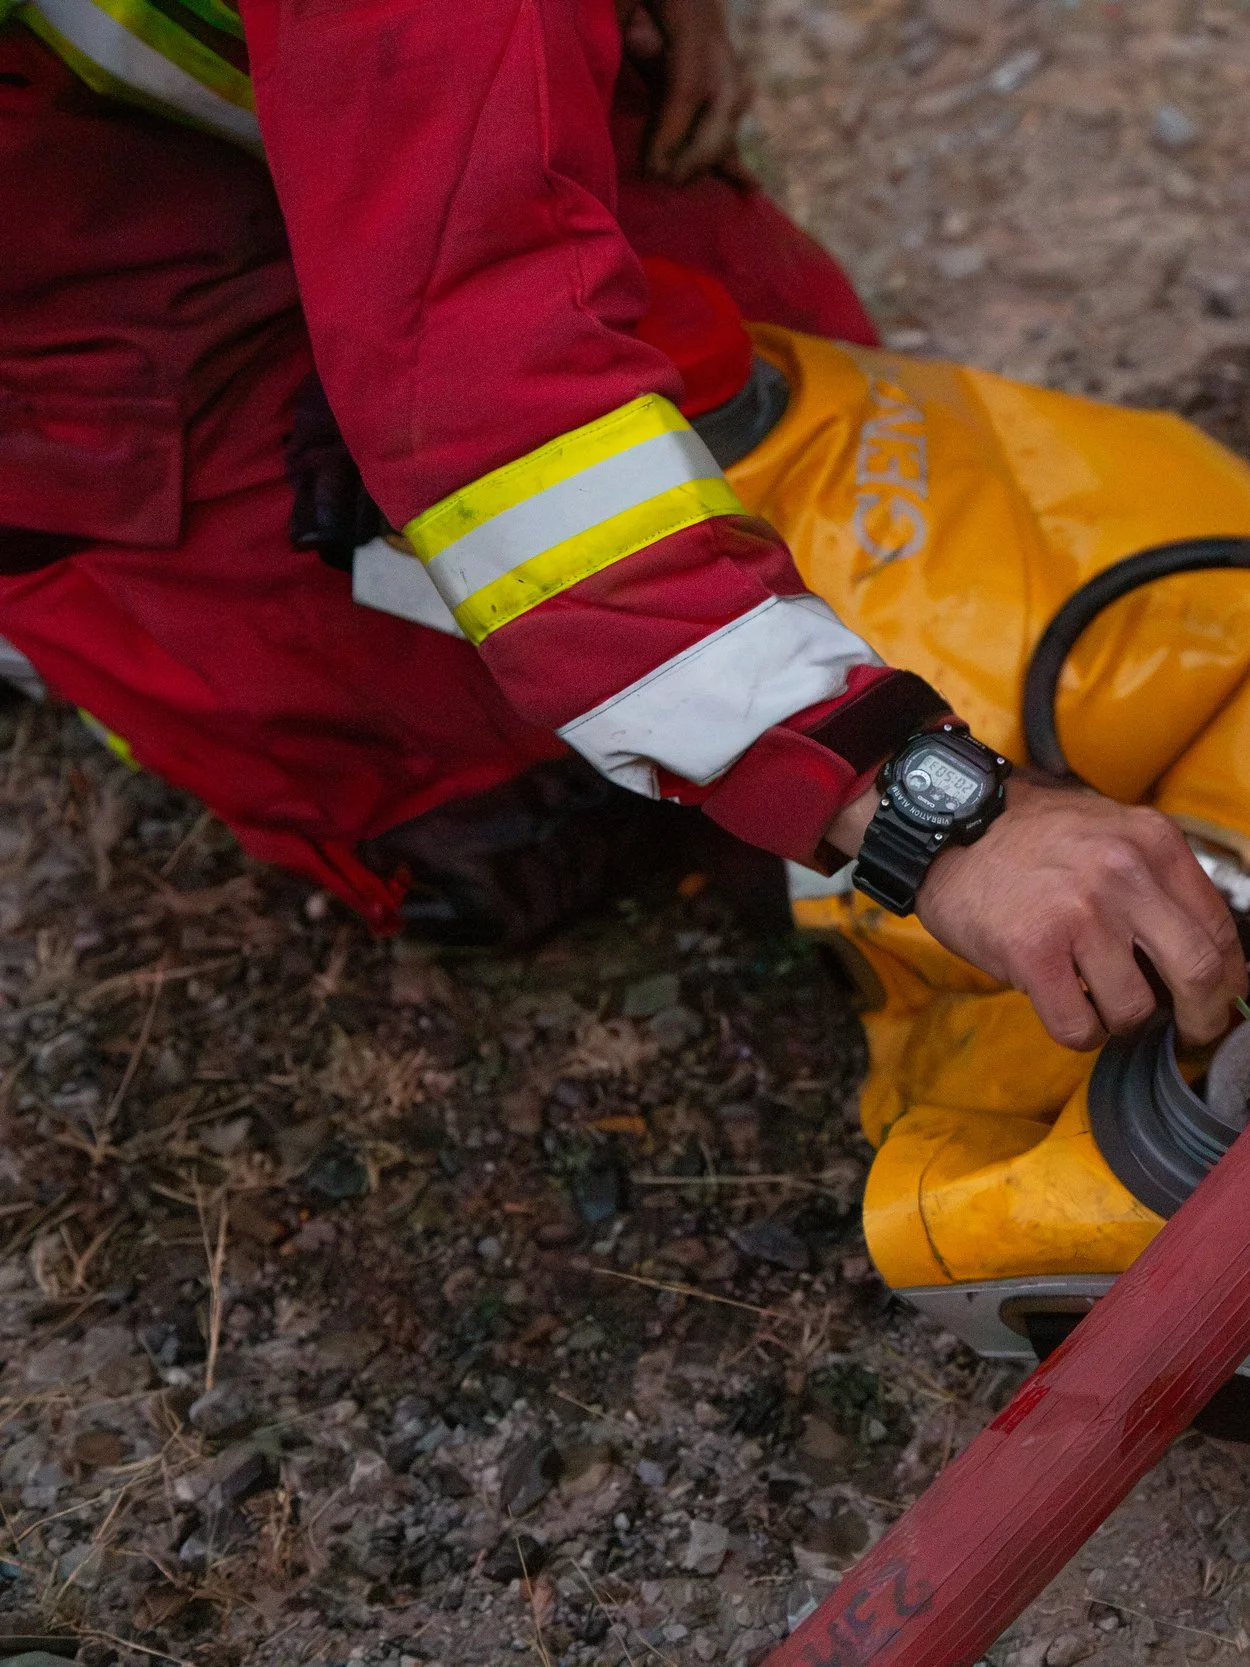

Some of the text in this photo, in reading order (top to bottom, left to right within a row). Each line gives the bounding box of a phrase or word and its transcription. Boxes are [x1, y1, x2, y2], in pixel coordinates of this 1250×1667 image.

[891, 785, 911, 809] ALARM
[917, 795, 936, 809] CASIO
[909, 806, 951, 826] VIBRATION
